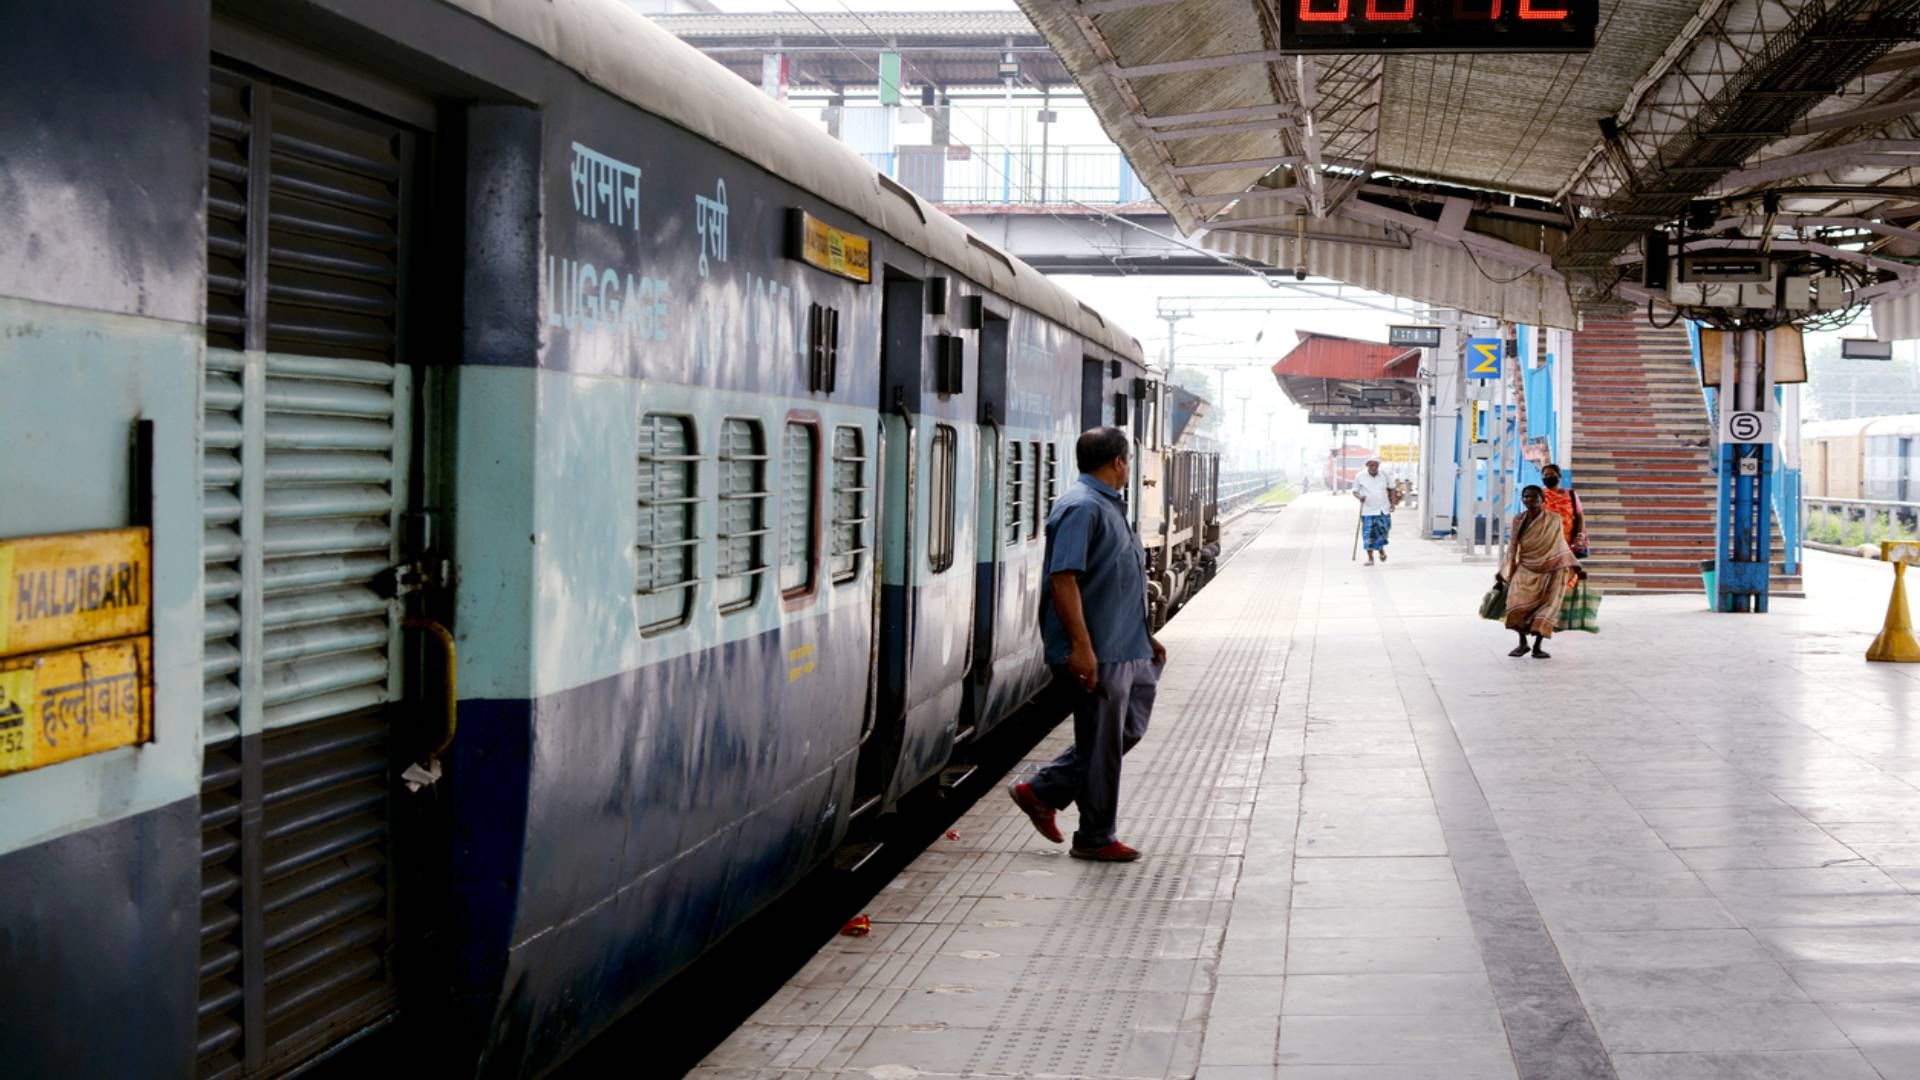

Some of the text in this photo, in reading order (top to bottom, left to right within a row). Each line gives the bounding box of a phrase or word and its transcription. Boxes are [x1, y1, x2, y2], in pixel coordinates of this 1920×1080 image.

[571, 140, 641, 231] सामान
[695, 178, 728, 280] पूसी
[549, 255, 670, 342] LUGGAGE
[17, 561, 139, 622] HALDIBARI
